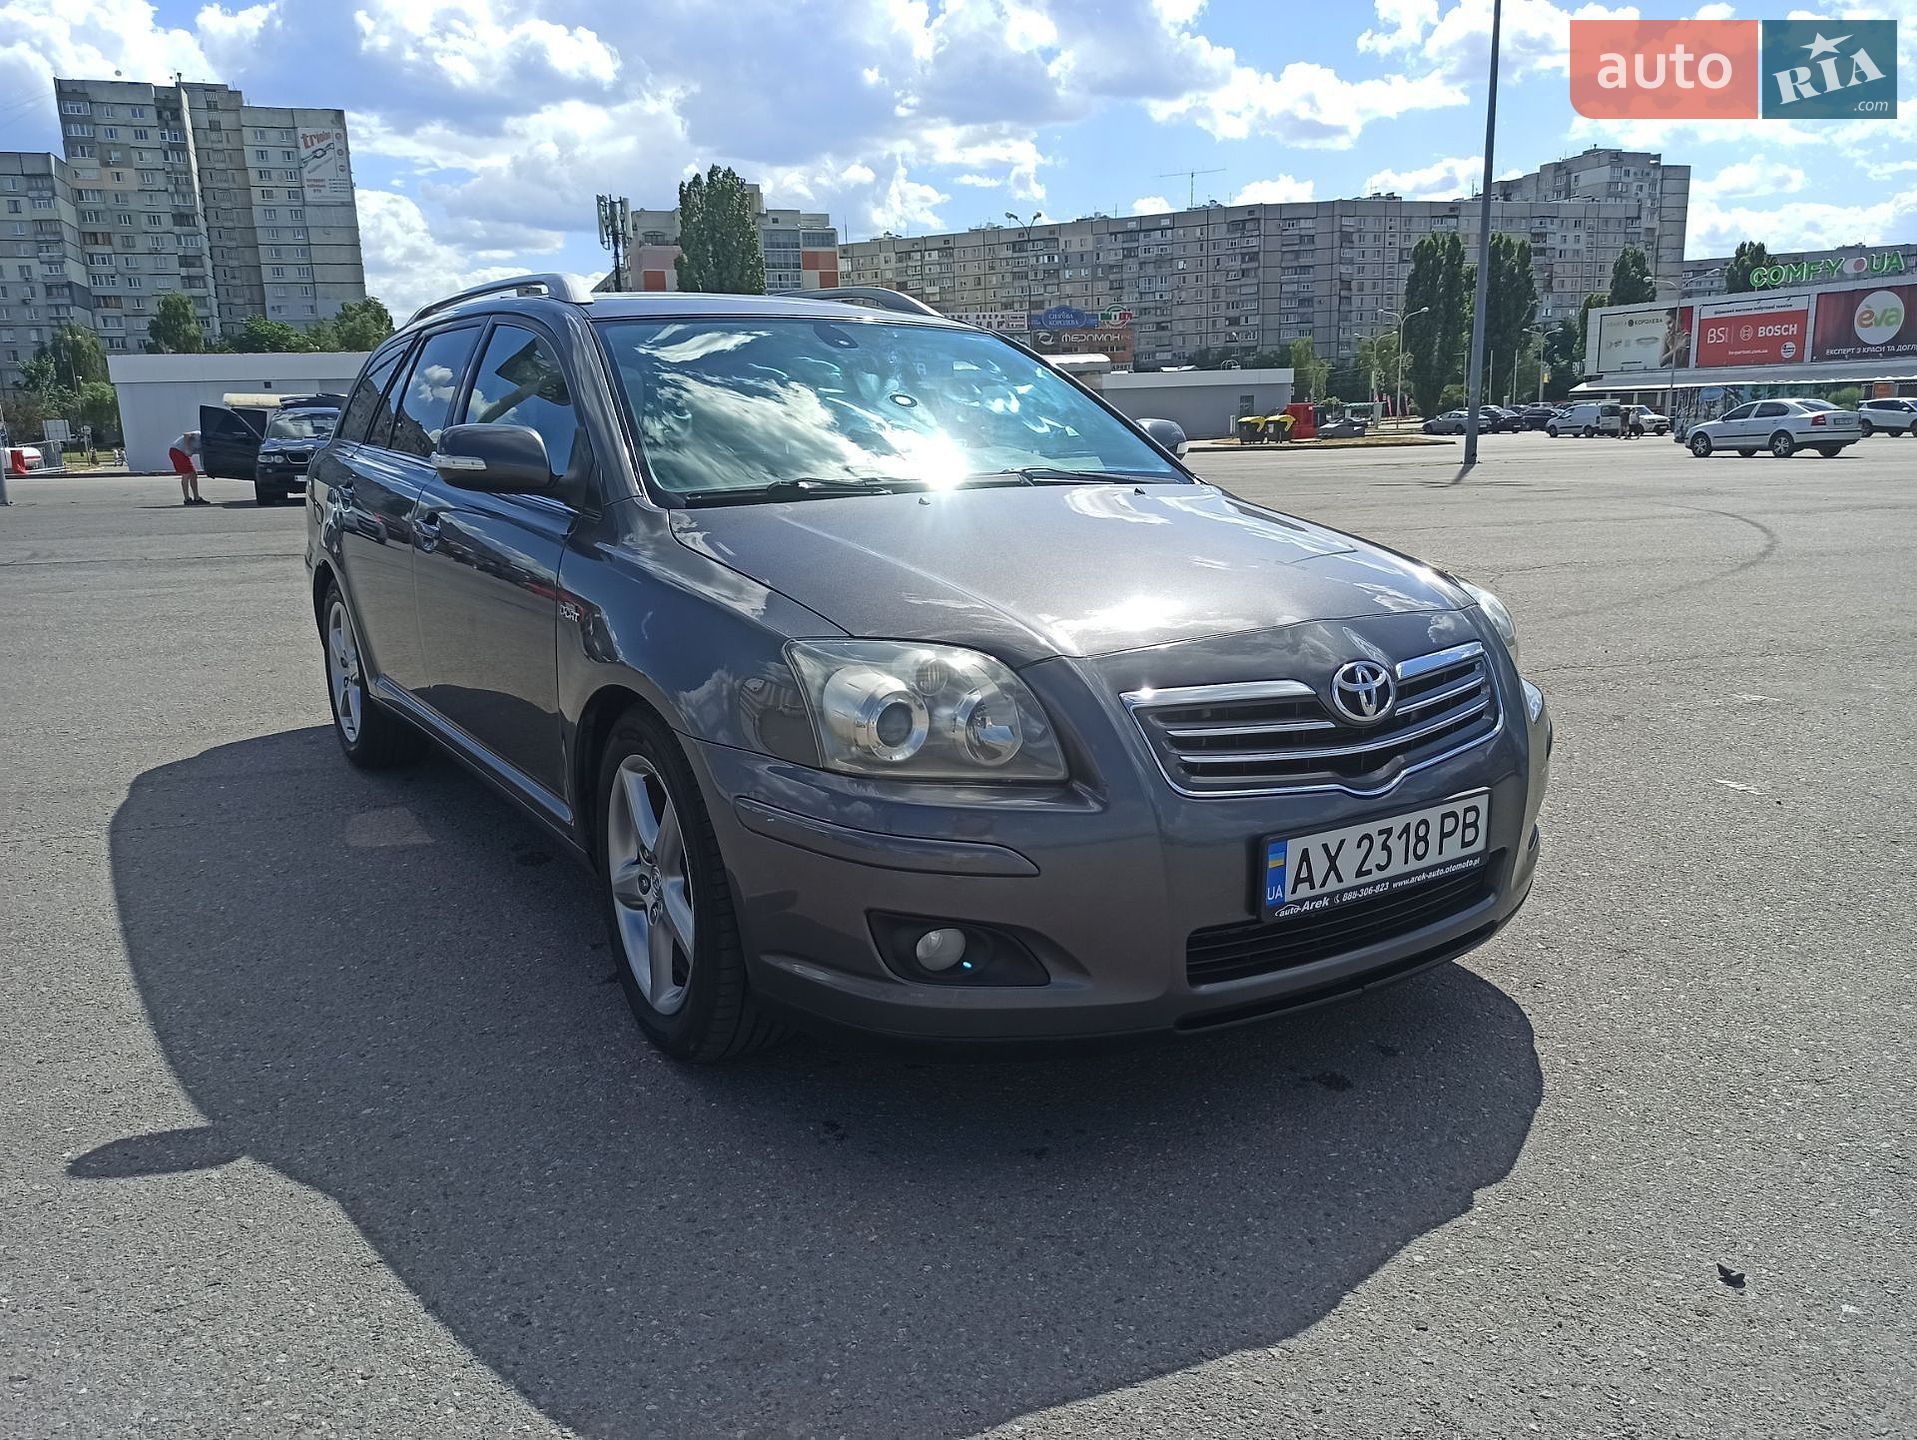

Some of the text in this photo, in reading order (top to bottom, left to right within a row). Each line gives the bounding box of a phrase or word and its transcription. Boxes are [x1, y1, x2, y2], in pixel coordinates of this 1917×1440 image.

[1750, 250, 1904, 287] COMFY UA
[1757, 323, 1798, 338] BOSCH
[1825, 347, 1856, 356] ЕКСПЕРТ
[1862, 346, 1886, 354] КРАСИ
[1290, 804, 1481, 895] AX 2318 PB
[1267, 888, 1283, 900] UA
